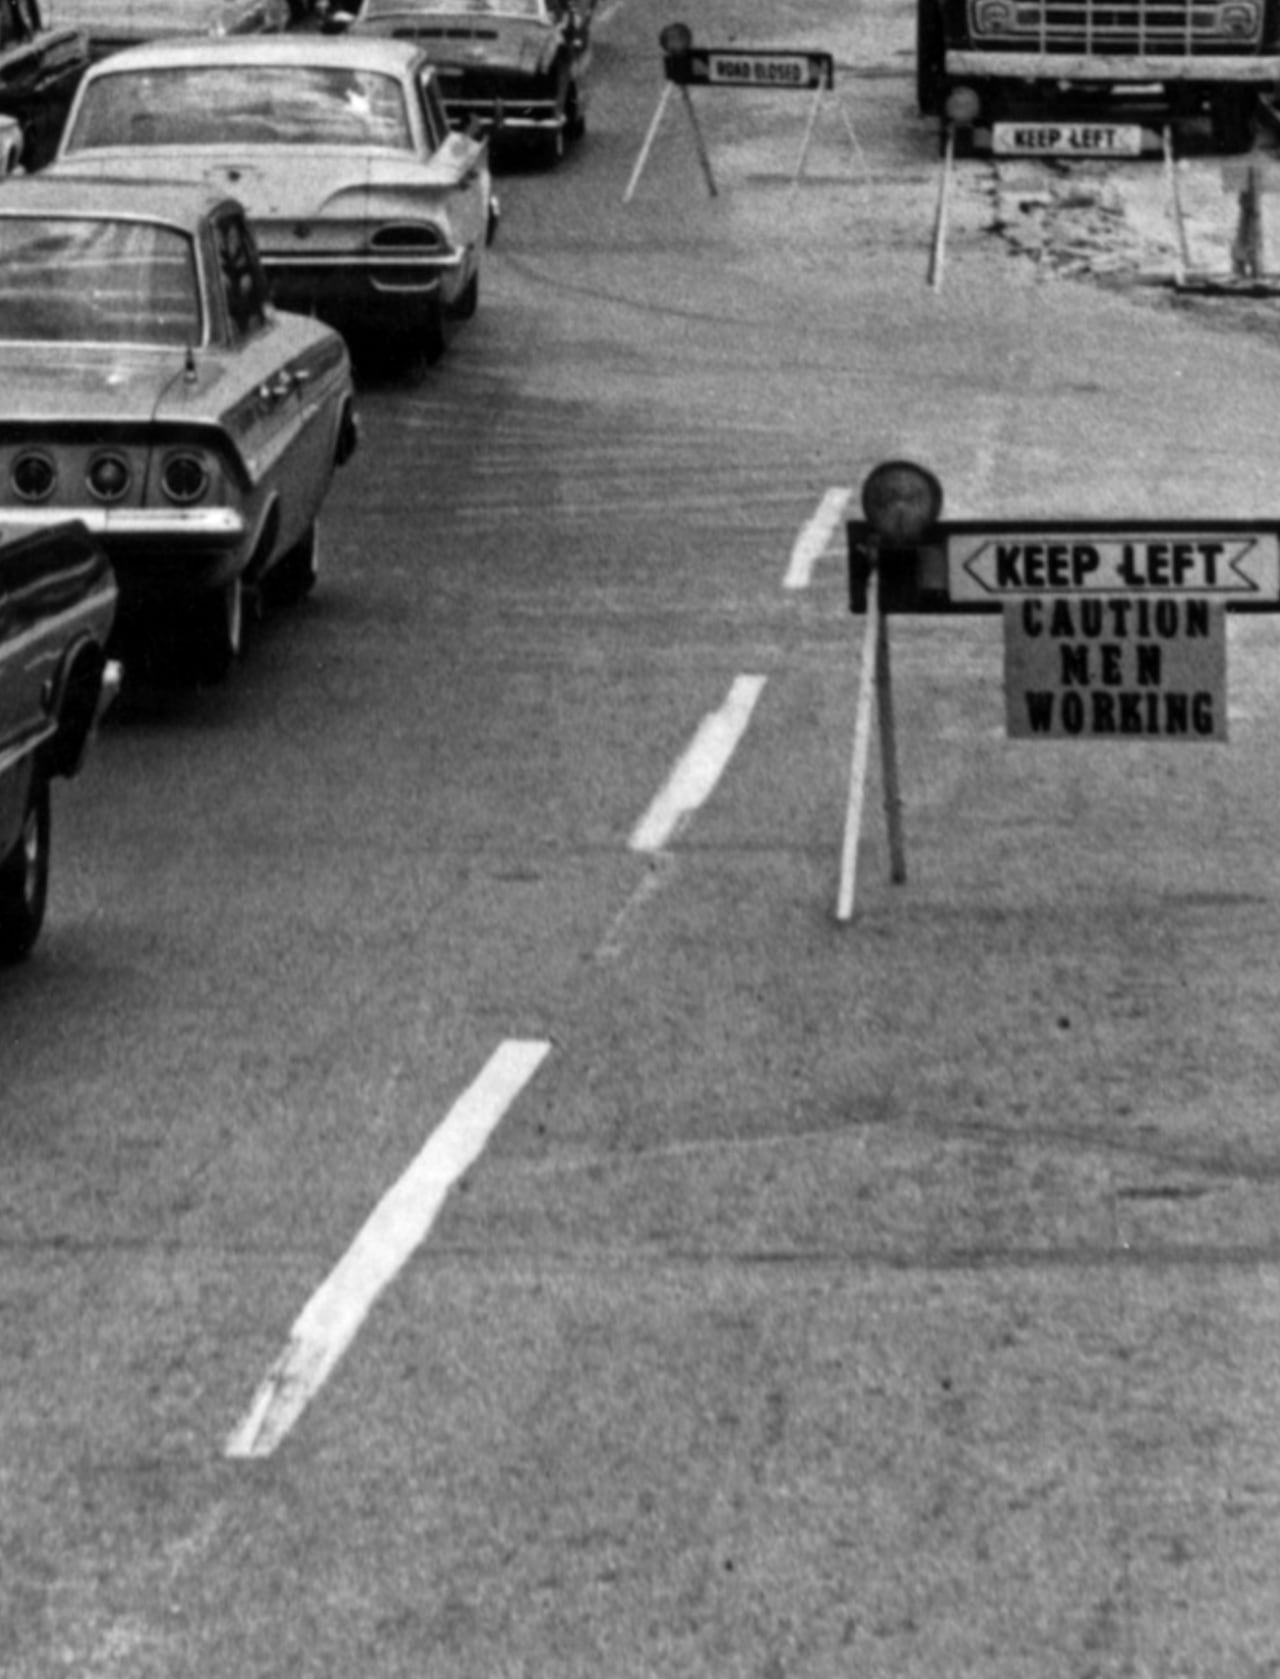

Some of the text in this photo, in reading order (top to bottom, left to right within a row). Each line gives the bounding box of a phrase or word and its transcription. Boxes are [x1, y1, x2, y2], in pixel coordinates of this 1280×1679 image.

[1014, 128, 1116, 149] KEEP LEFT
[995, 543, 1223, 587] KEEP LEFT
[1022, 599, 1210, 638] CAUTION
[1060, 644, 1162, 686] MEN
[1025, 691, 1213, 734] WORKING
